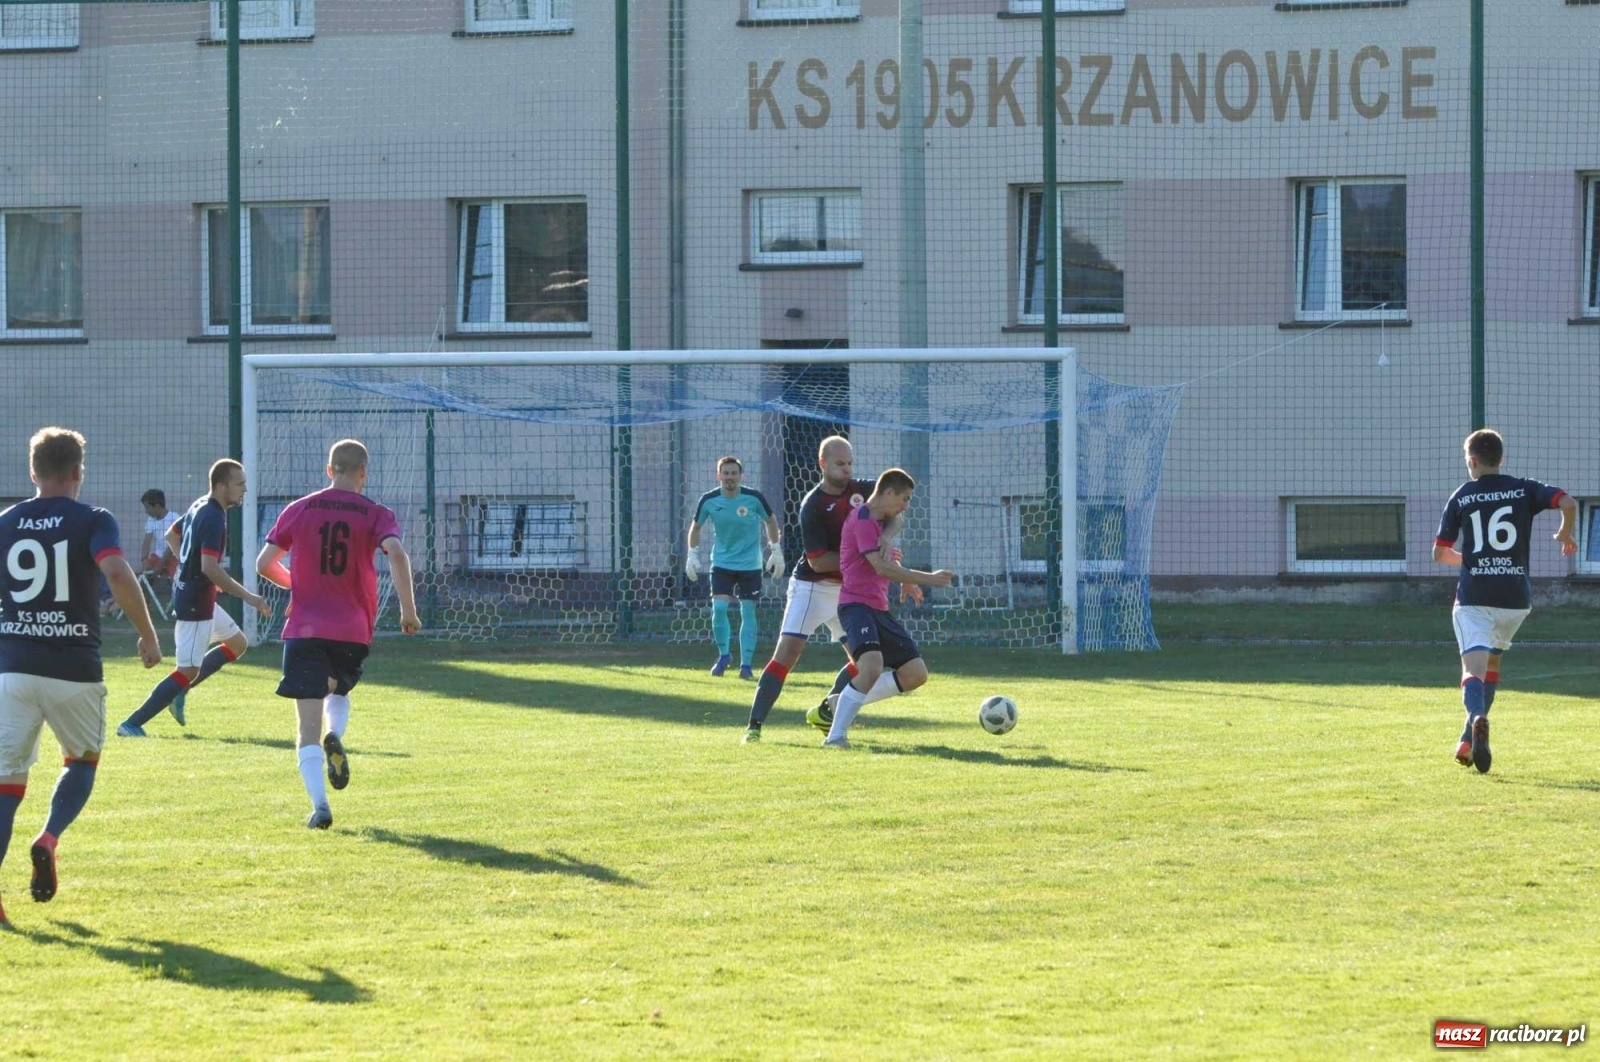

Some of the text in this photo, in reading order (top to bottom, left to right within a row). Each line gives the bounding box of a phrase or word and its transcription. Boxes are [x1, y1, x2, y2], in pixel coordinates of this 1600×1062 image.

[747, 44, 1438, 130] KS 1905 KRZANOWICE
[1457, 488, 1525, 507] HRYCKIEWICZ
[17, 516, 64, 530] JASNY
[1469, 505, 1517, 553] 16
[319, 520, 350, 576] 16
[6, 538, 70, 604] 91
[1478, 557, 1513, 568] KS 1905
[17, 610, 67, 624] KS 1905
[0, 621, 89, 637] KRZANOWICE
